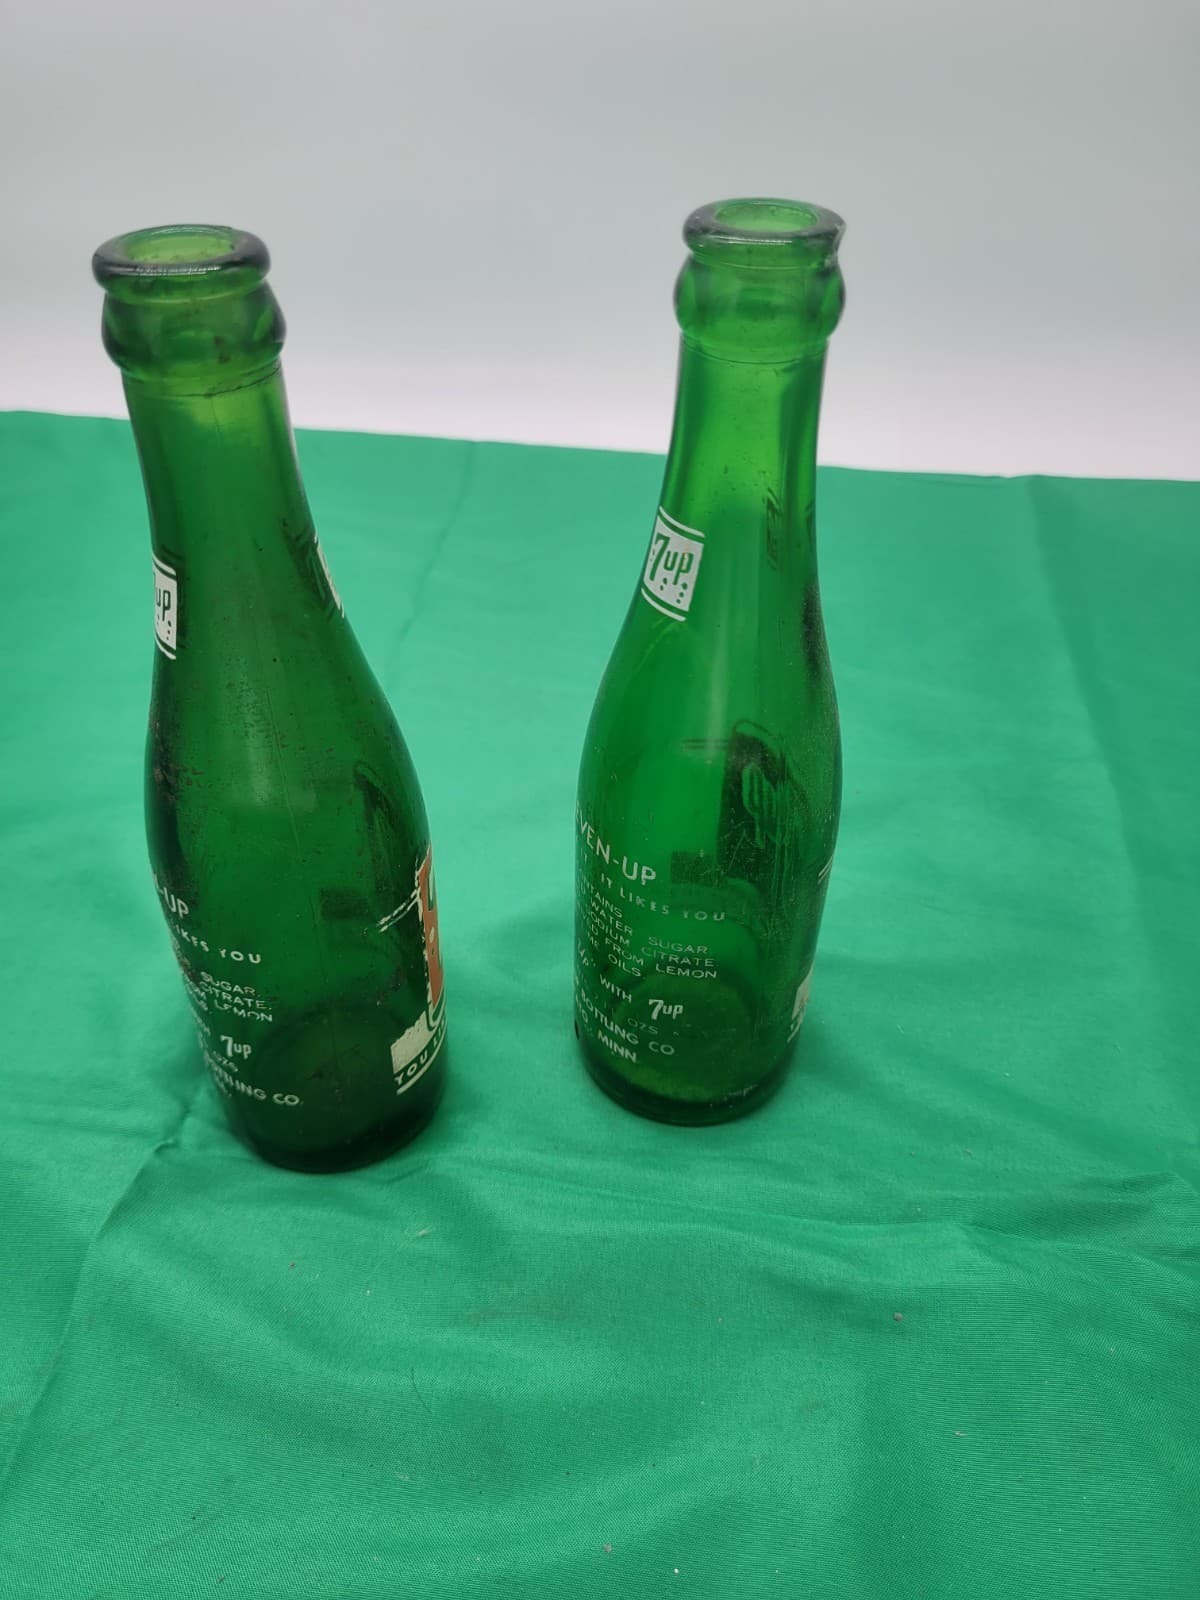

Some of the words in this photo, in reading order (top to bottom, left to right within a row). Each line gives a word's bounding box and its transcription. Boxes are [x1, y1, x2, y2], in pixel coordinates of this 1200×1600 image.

[683, 910, 725, 921] YOU
[648, 936, 709, 955] SUGAR
[219, 949, 261, 964] YOU
[655, 963, 717, 979] LEMON
[600, 974, 632, 1003] WITH
[394, 1049, 428, 1086] YOU
